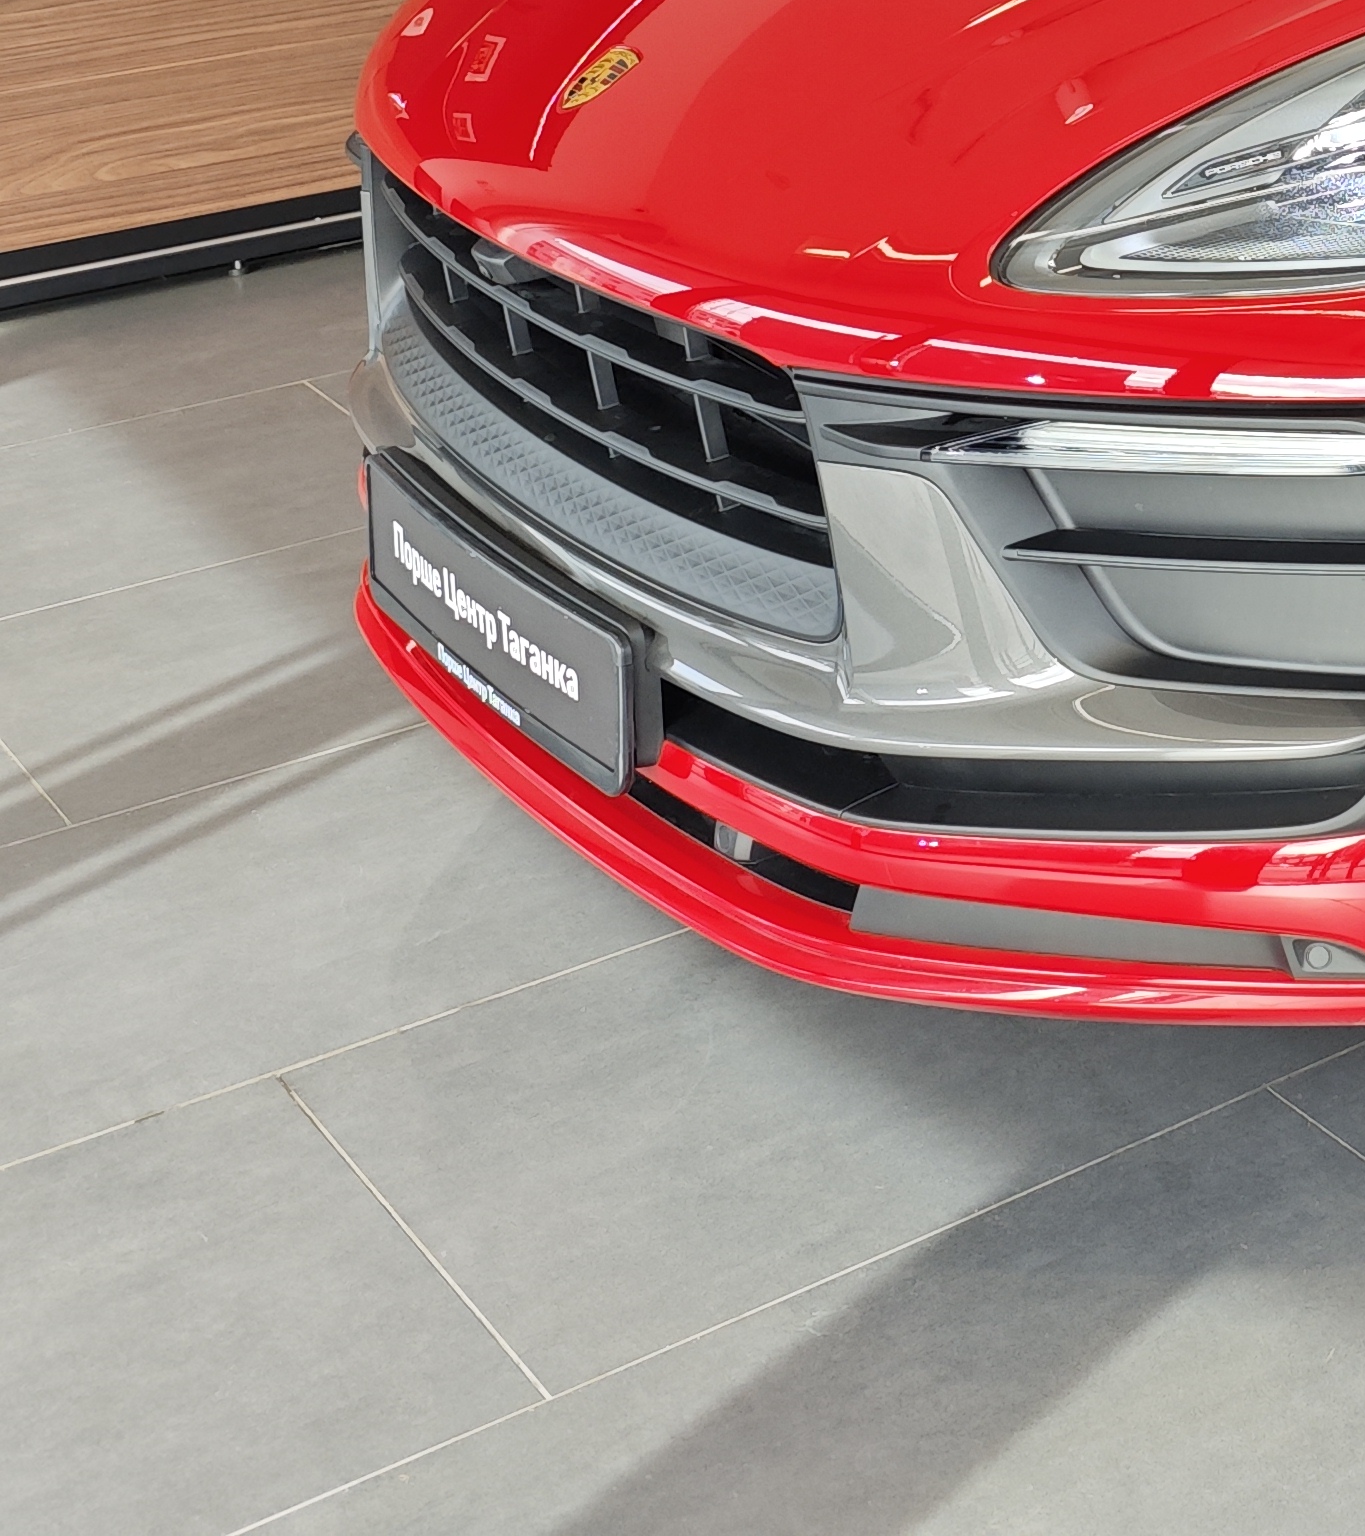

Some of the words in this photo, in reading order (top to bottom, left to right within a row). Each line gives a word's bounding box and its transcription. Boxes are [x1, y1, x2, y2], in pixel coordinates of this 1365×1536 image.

[1205, 150, 1282, 177] PORSCHE
[393, 520, 443, 599] Порше
[443, 567, 497, 649] Центр
[497, 610, 579, 701] Таганка
